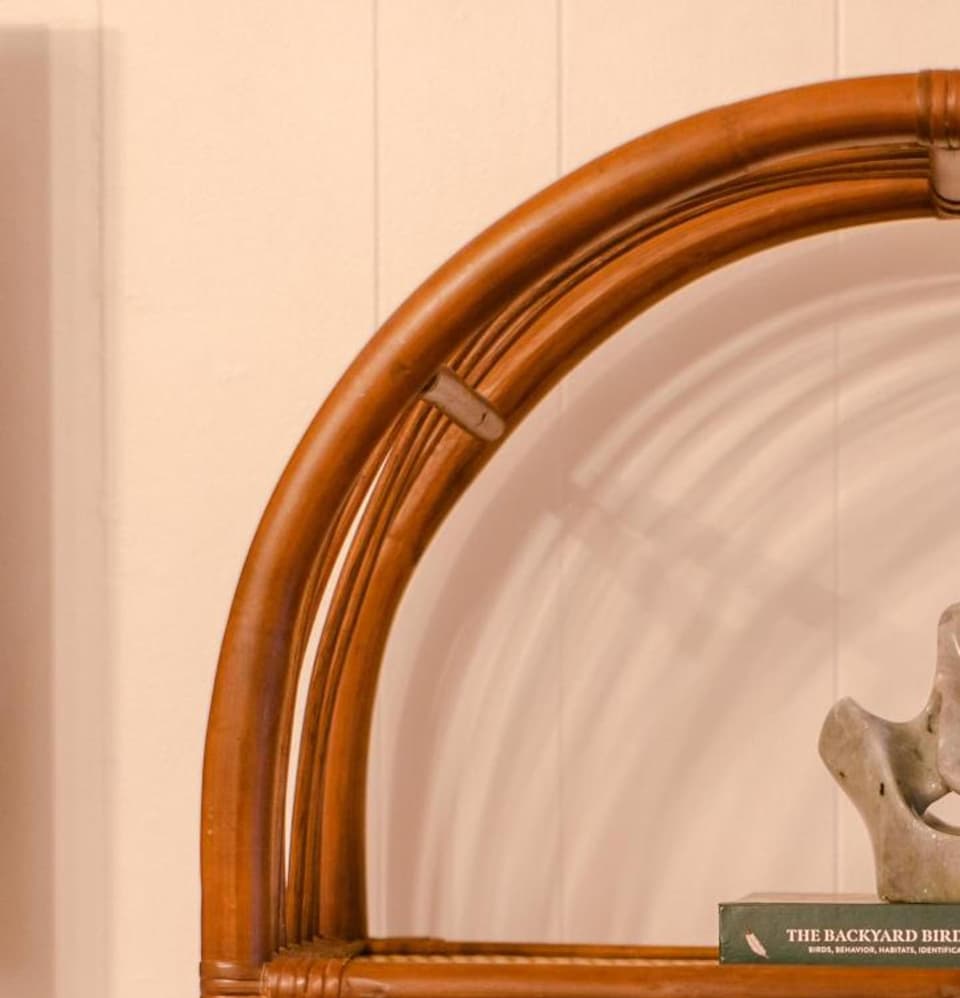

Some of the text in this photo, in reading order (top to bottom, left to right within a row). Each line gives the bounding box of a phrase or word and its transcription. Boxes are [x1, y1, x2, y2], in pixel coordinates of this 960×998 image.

[786, 929, 821, 942] THE
[824, 929, 917, 942] BACKYARD
[808, 946, 834, 954] BIRDS,
[835, 946, 877, 954] BEHAVIOR,
[878, 946, 917, 954] HABITATS,
